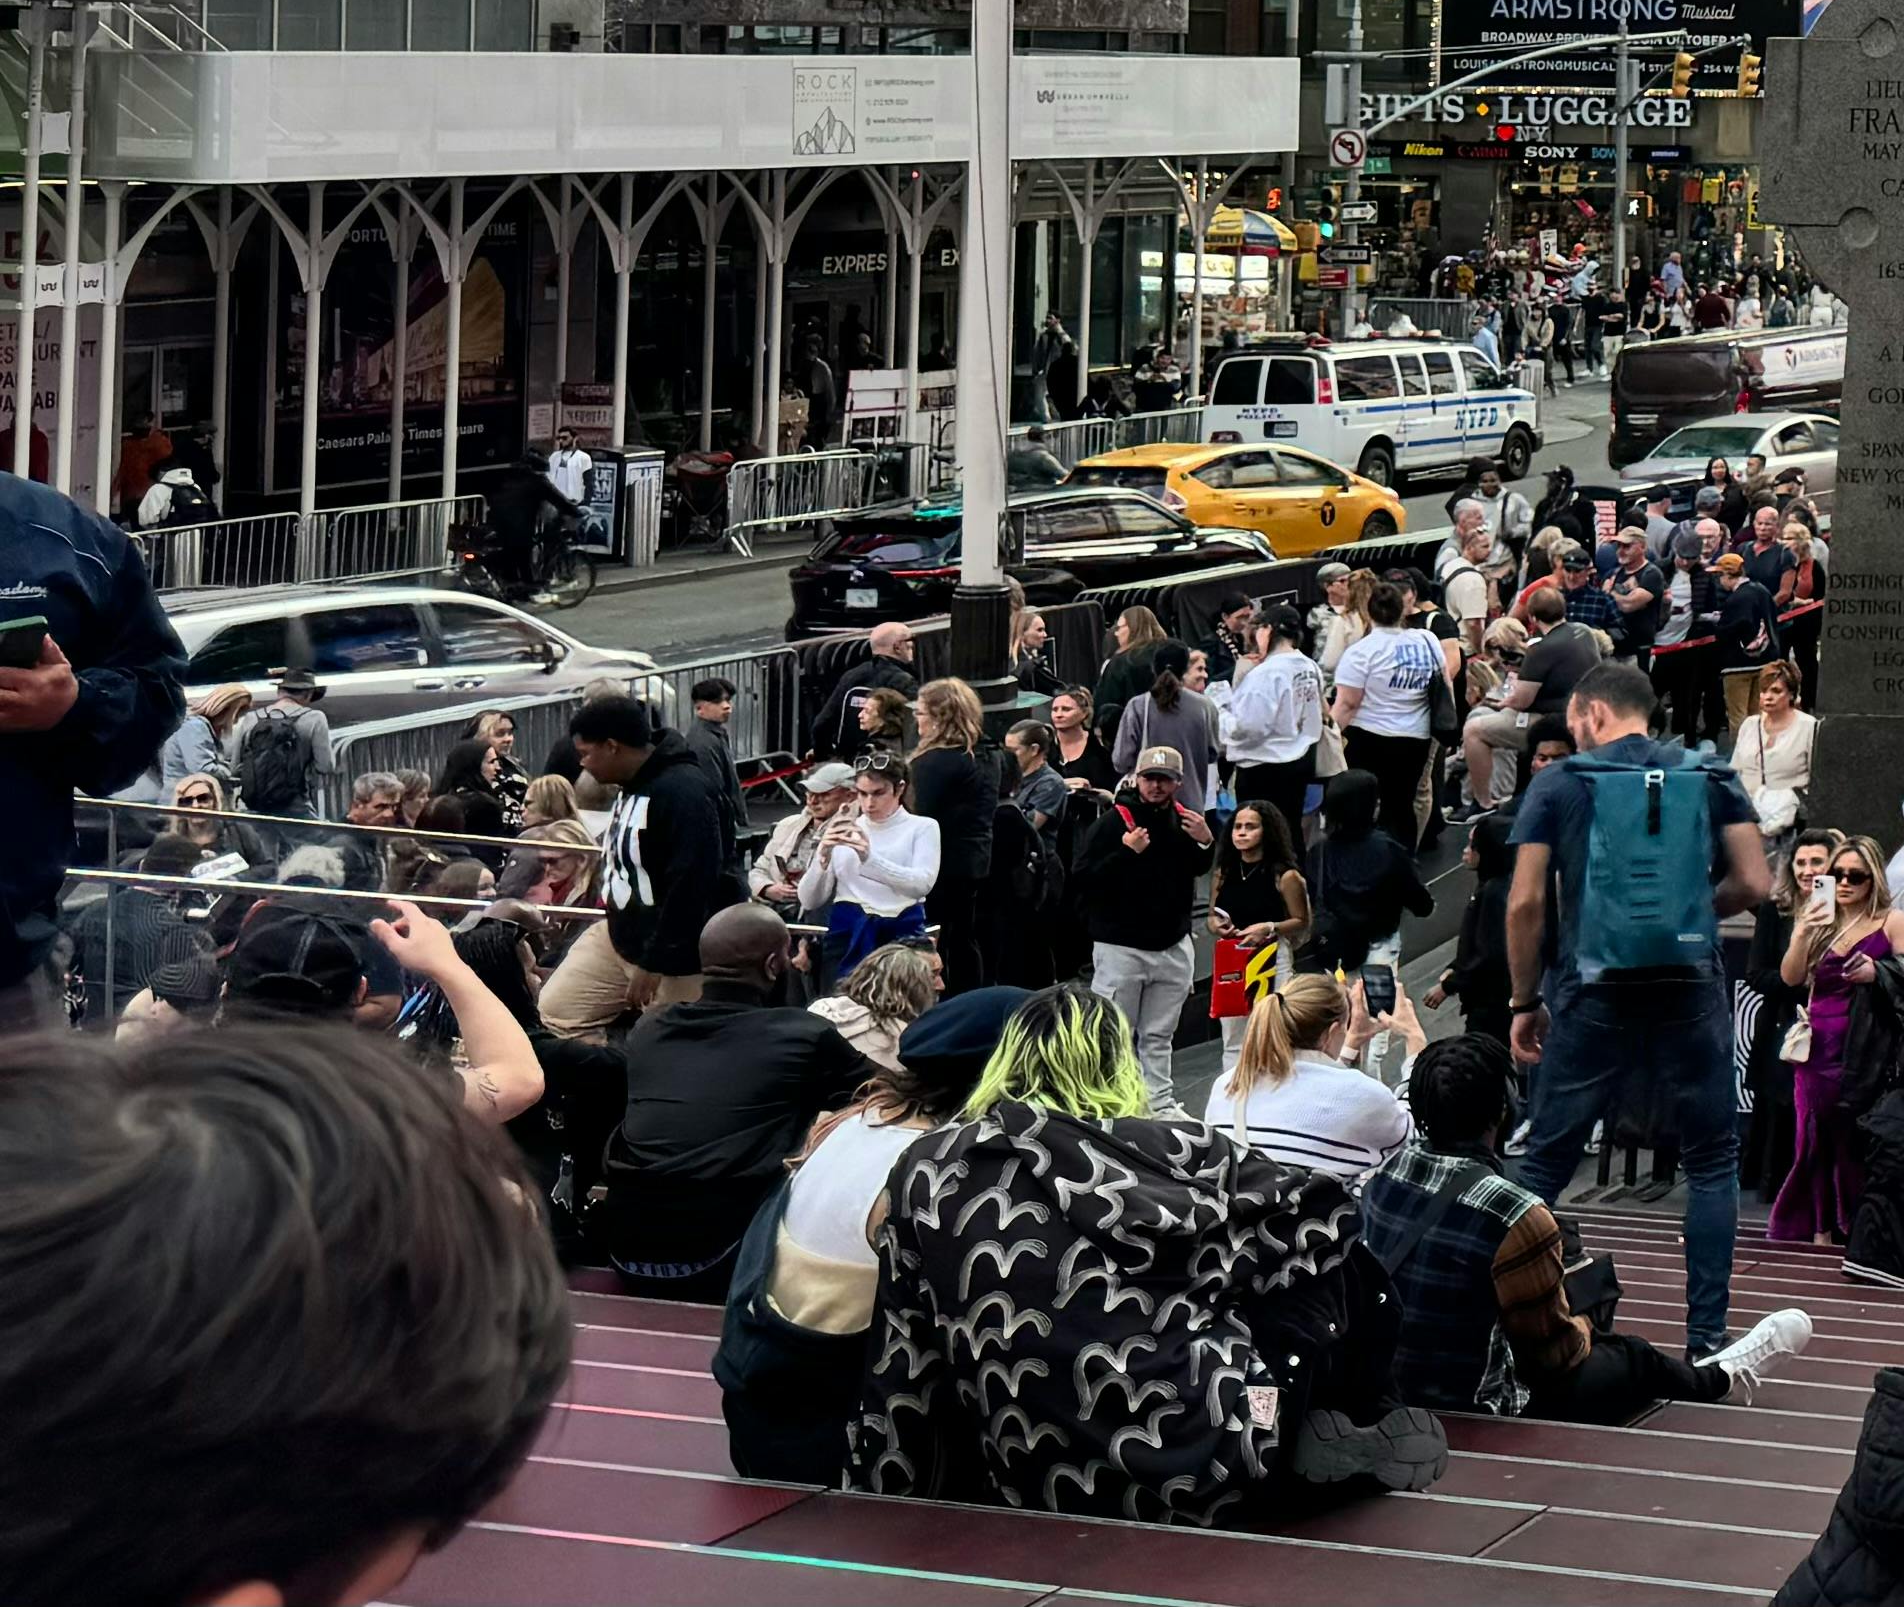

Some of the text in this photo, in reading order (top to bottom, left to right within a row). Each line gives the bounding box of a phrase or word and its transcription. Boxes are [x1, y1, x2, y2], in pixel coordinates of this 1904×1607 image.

[1681, 3, 1736, 20] Musical
[1481, 31, 1552, 43] BROADWAY
[796, 74, 853, 89] ROCK
[1516, 125, 1550, 143] NY
[1404, 143, 1444, 156] Nikon
[1457, 145, 1511, 158] Canon
[1524, 146, 1579, 159] SONY
[1862, 144, 1902, 160] MAY
[1454, 407, 1498, 430] NYPD
[316, 427, 443, 451] Caesars Times
